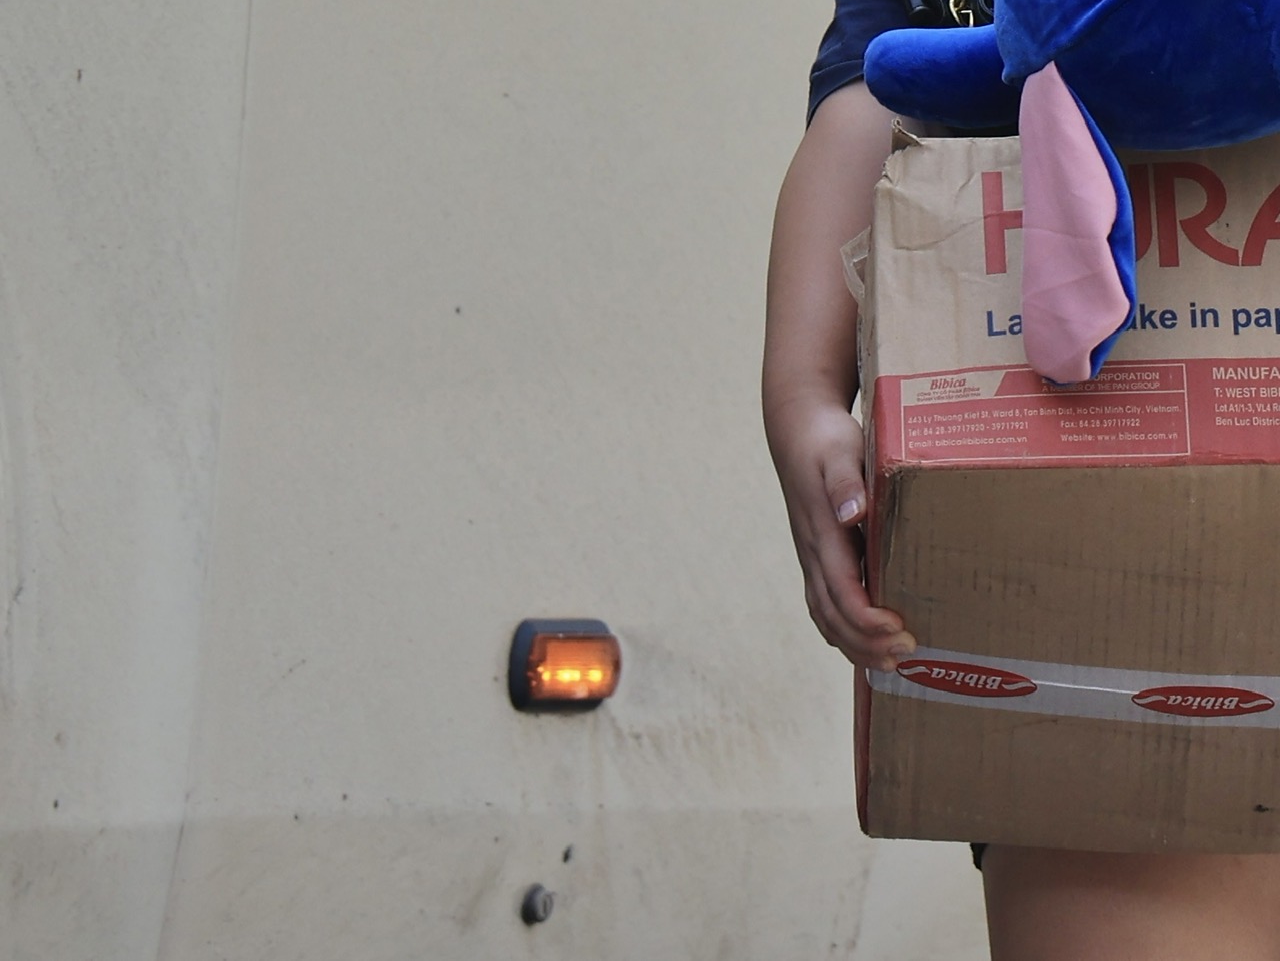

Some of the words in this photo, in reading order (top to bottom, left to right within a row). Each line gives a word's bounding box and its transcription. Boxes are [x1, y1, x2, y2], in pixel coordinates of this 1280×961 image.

[1190, 302, 1219, 329] in
[930, 379, 966, 390] Bibica
[1214, 387, 1222, 397] T:
[1225, 387, 1256, 397] WEST
[1215, 403, 1227, 413] Lot
[1256, 403, 1270, 412] VL4
[1216, 417, 1232, 425] Ben
[1234, 417, 1250, 425] Luc
[930, 667, 1003, 690] Bibica
[1167, 694, 1240, 710] Bibica
